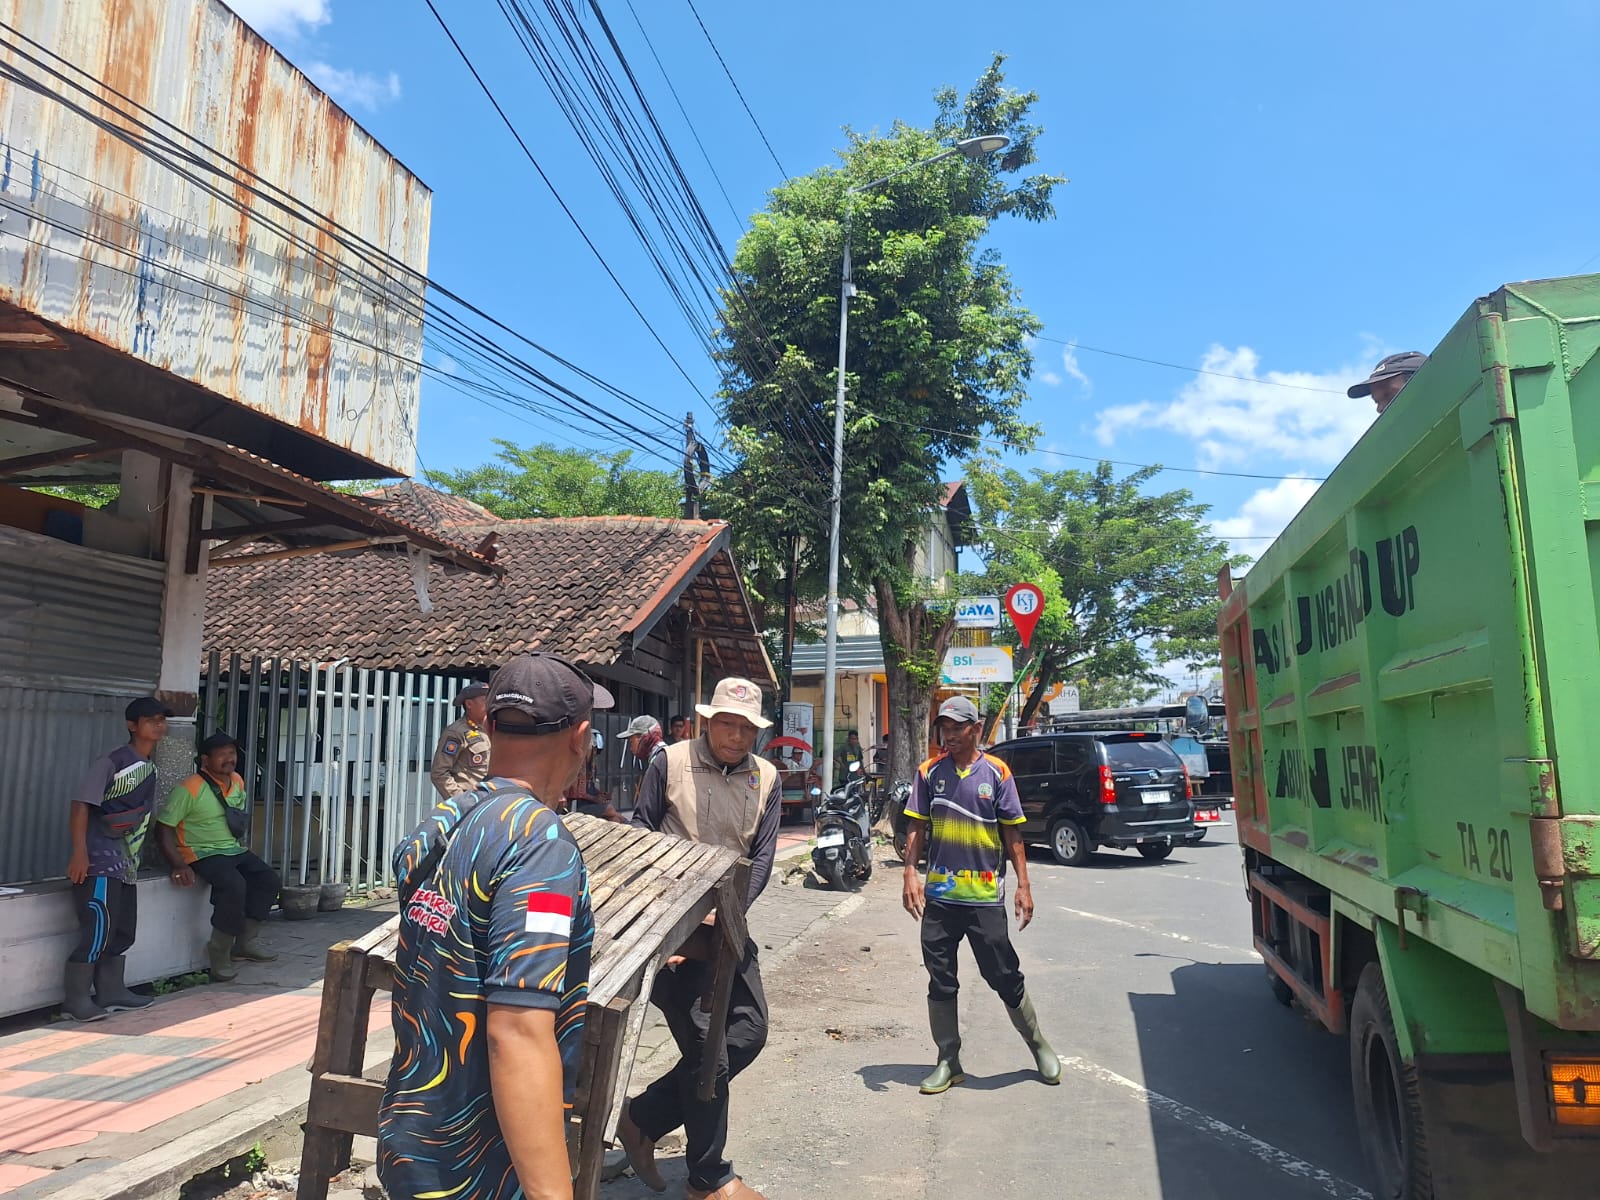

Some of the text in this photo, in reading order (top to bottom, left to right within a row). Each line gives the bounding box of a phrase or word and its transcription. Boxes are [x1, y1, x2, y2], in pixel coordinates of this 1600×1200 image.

[959, 604, 994, 616] JAYA
[953, 656, 972, 666] BSI
[1456, 821, 1481, 874] TA
